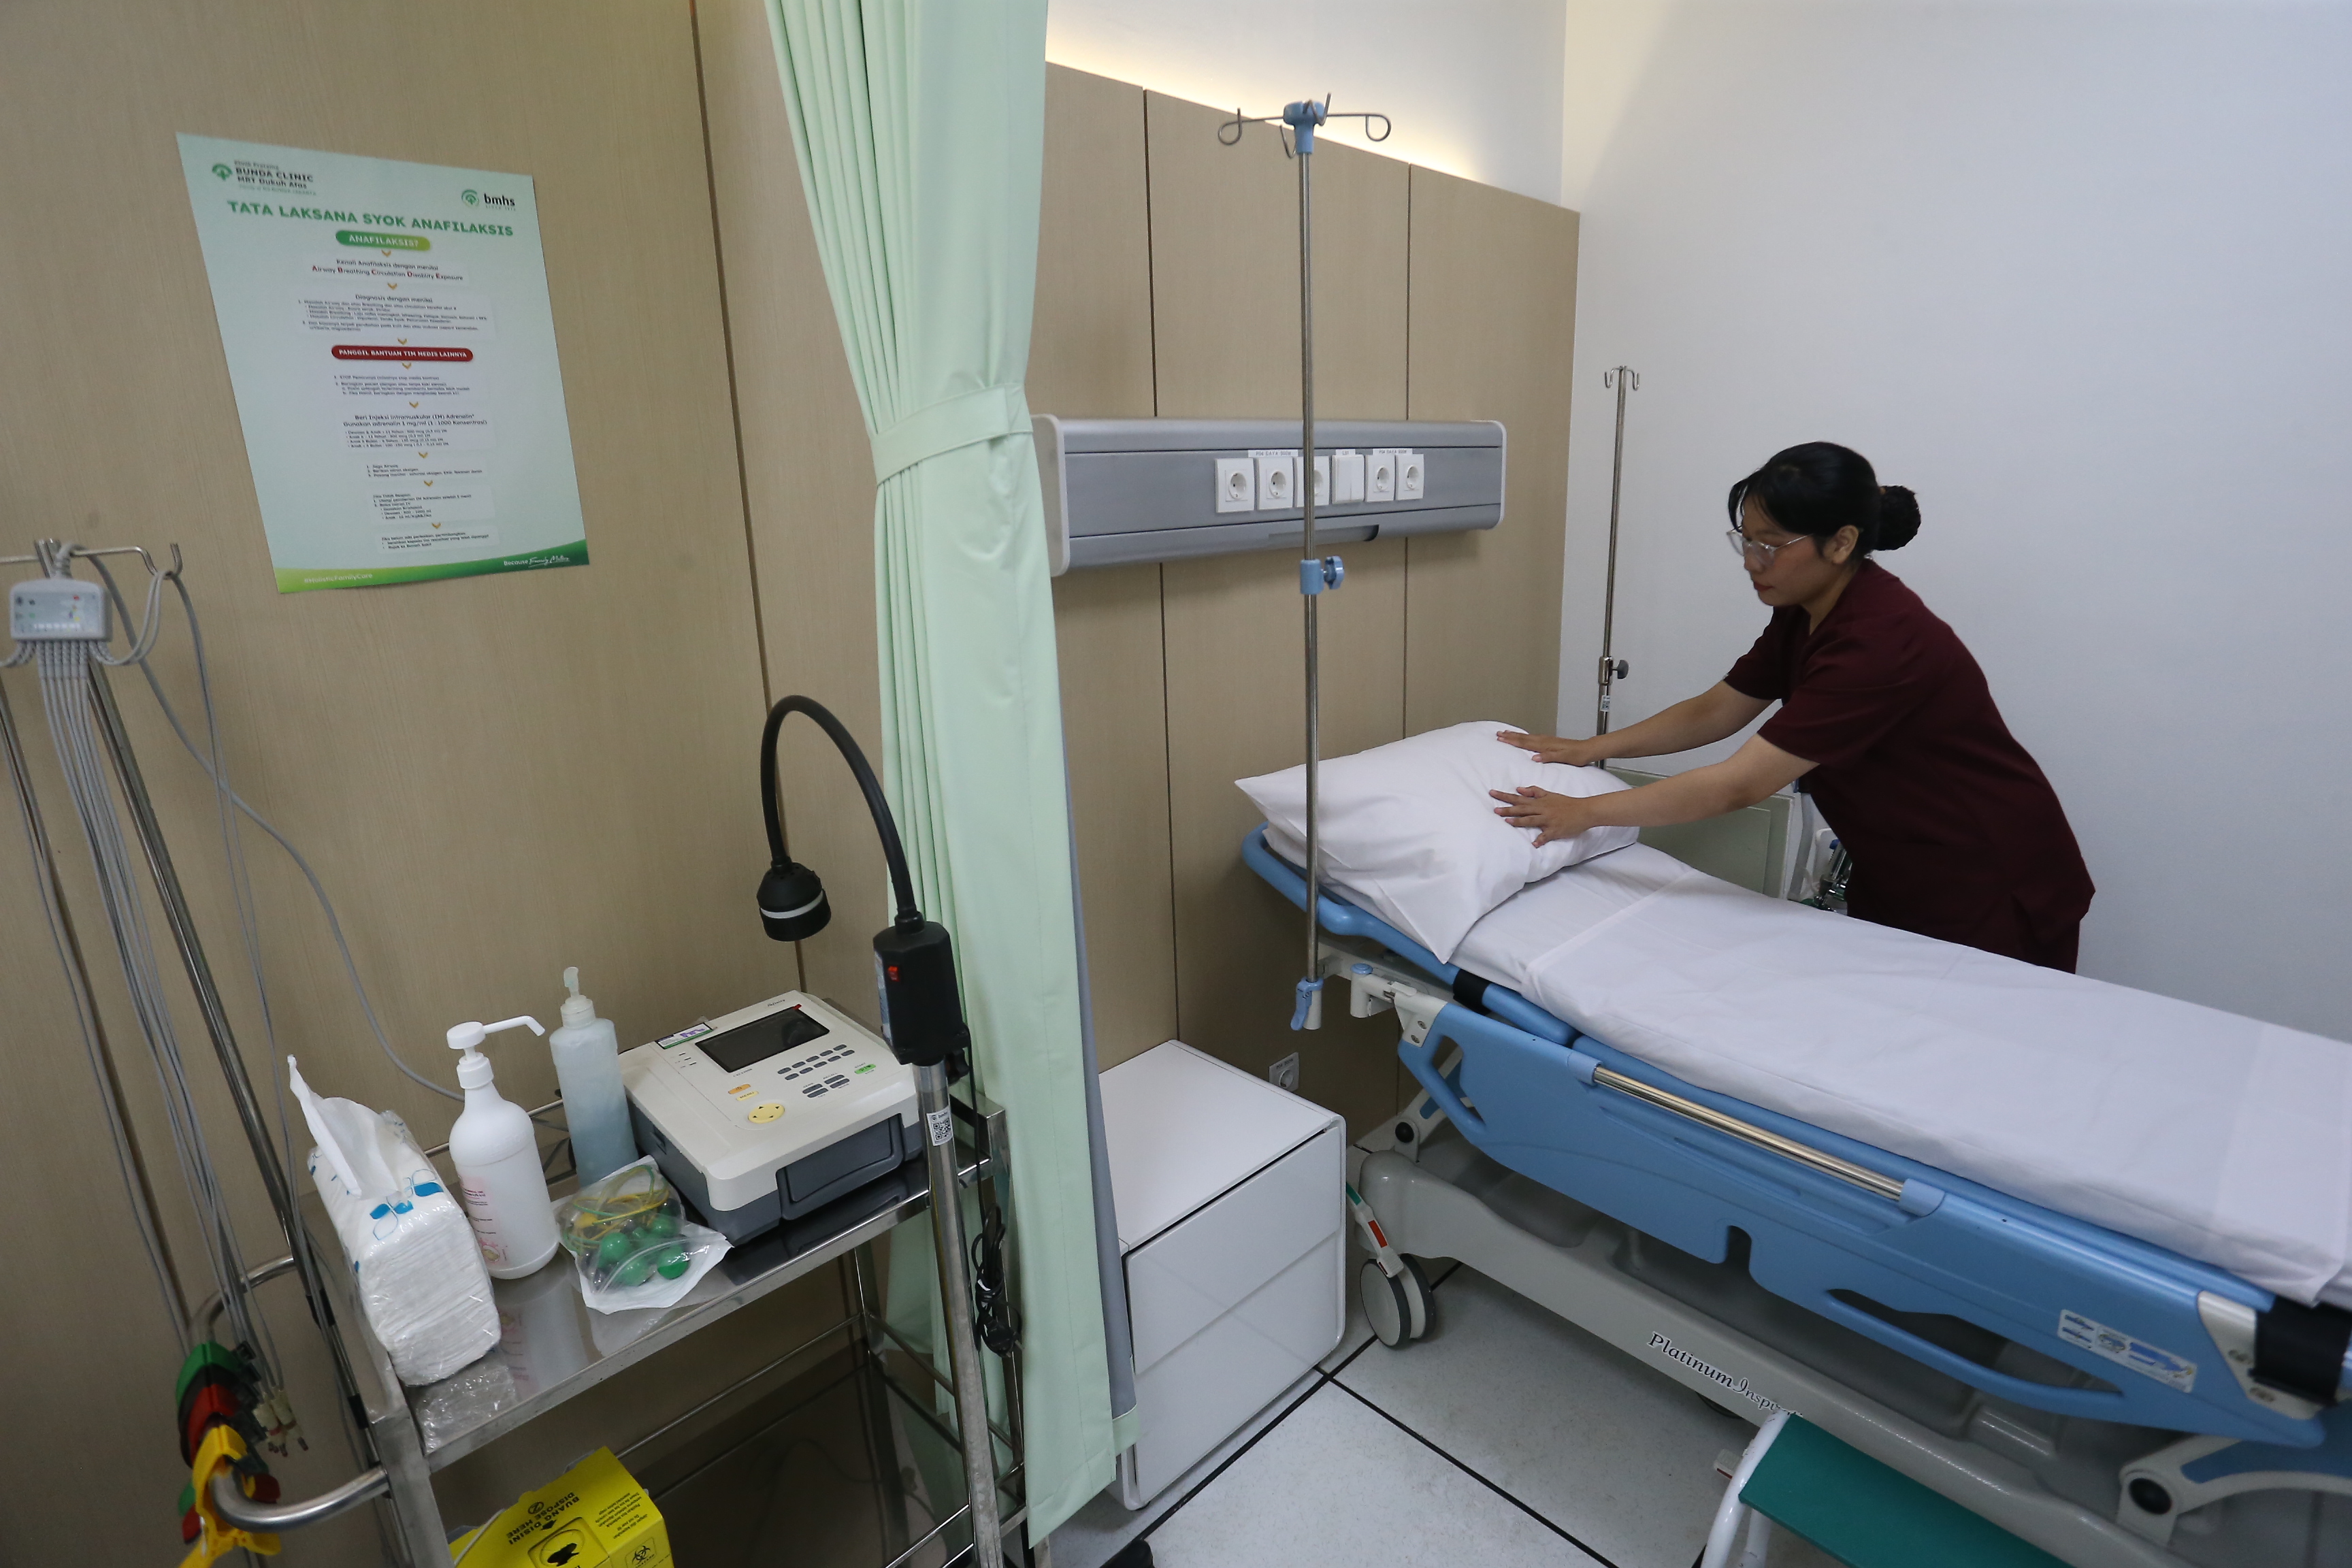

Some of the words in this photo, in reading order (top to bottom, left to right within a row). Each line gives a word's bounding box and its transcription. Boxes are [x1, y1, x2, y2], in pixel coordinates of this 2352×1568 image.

[236, 167, 272, 178] BUNDA
[276, 172, 314, 182] CLINIC
[289, 181, 308, 189] Atas
[484, 193, 516, 207] bmhs
[227, 201, 274, 216] TATA
[278, 206, 358, 224] LAKSANA
[363, 214, 406, 228] SYOK
[412, 218, 514, 237] ANAFILAKSIS
[349, 234, 419, 248] ANAFILAKSIS?
[1648, 1333, 1732, 1388] Platinum
[534, 1492, 574, 1520] DISPOSE
[544, 1497, 580, 1521] BUANG
[506, 1519, 533, 1538] HERE
[509, 1522, 542, 1545] DISINI
